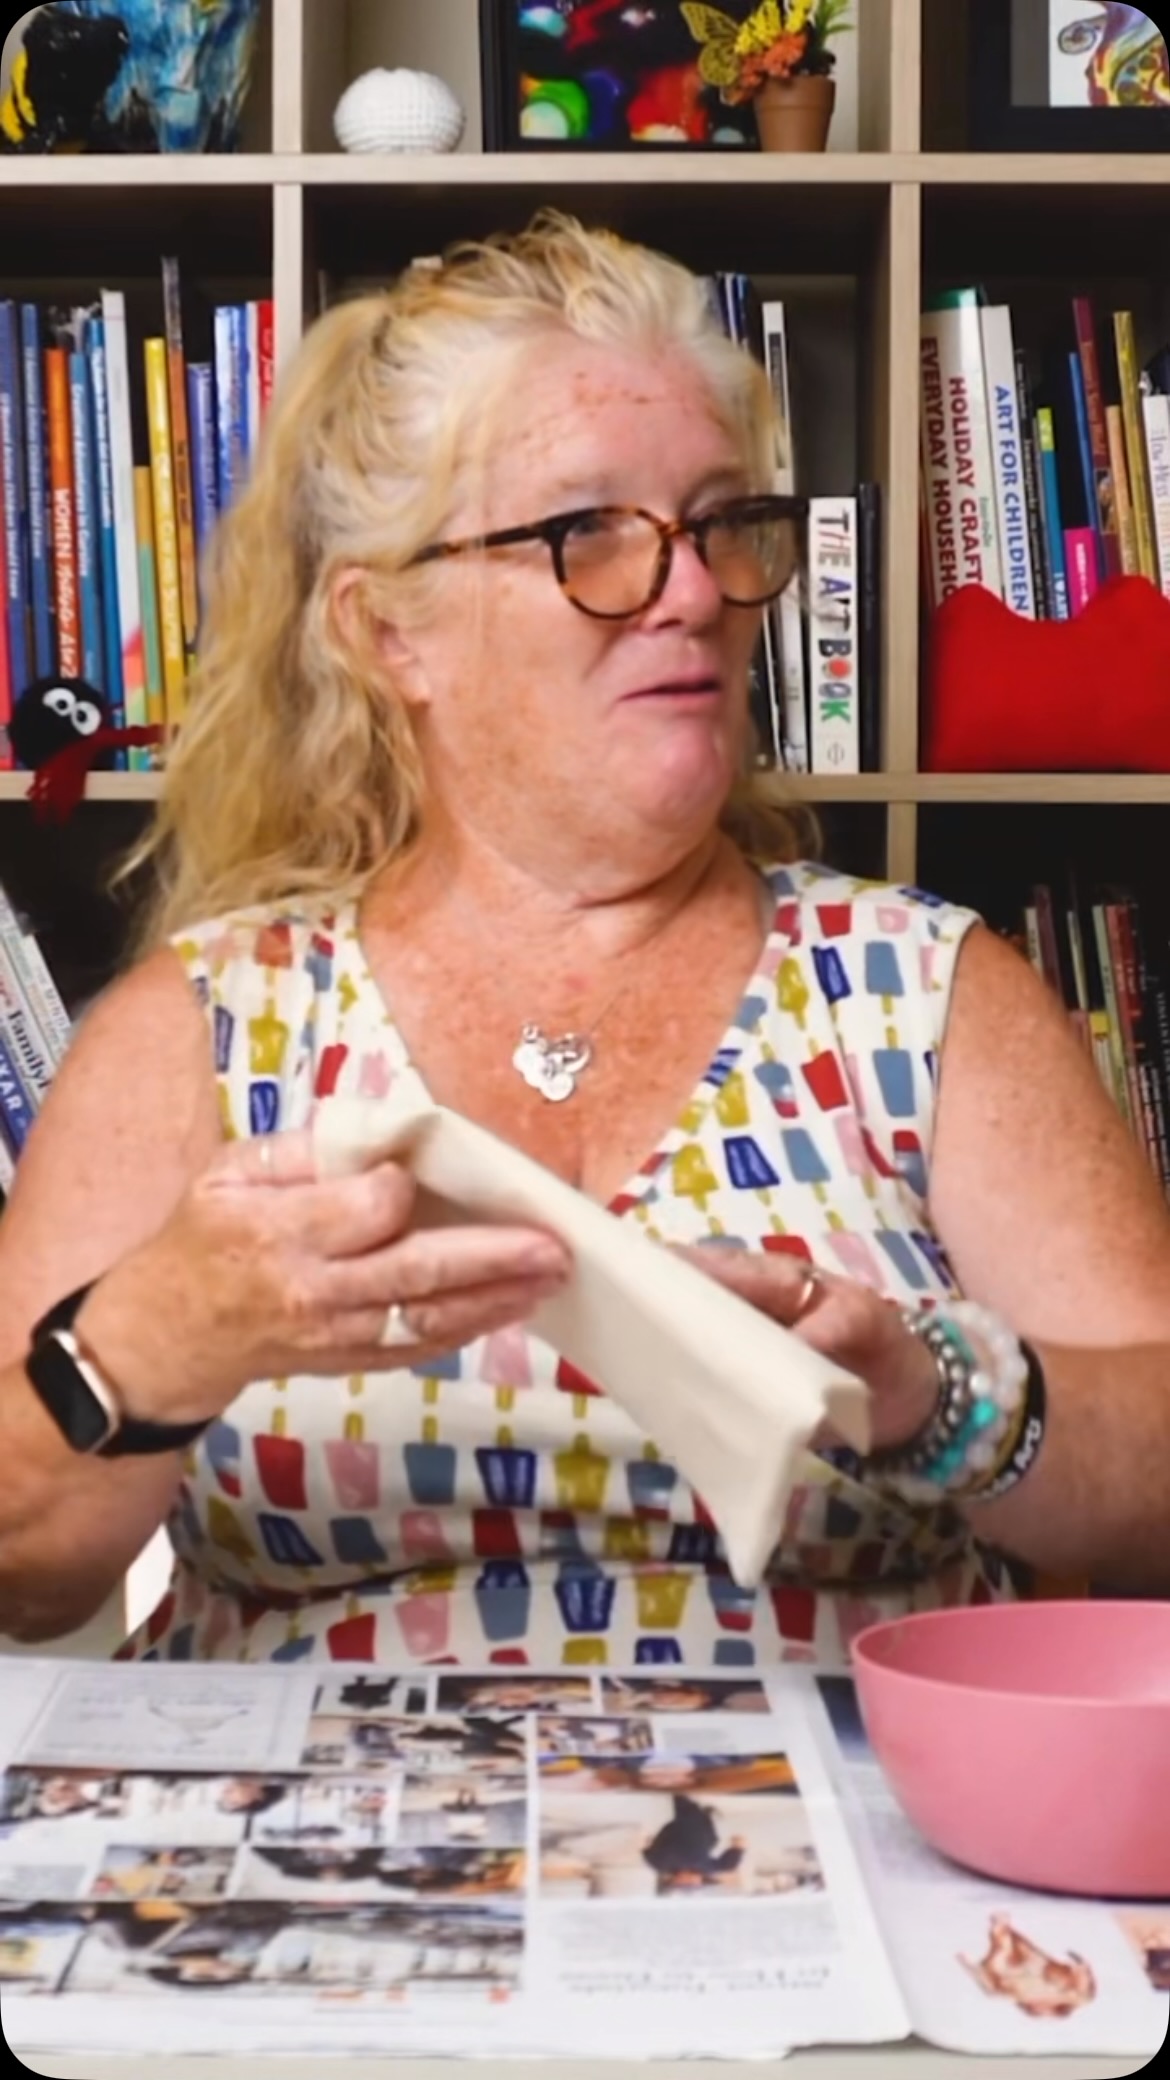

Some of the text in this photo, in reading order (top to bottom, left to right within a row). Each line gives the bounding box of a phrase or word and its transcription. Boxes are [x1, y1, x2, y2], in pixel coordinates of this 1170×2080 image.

[26, 406, 38, 441] Artists
[1, 445, 13, 479] Artists
[28, 443, 40, 487] Children
[72, 440, 90, 512] Adventures
[921, 337, 958, 598] EVERYDAY HOUSEHO
[949, 377, 983, 583] HOLIDAY CRAFT
[3, 482, 16, 527] Children
[30, 490, 42, 526] Should
[77, 514, 89, 527] in
[995, 386, 1029, 611] ART FOR CHILDREN
[32, 528, 43, 558] Know
[53, 487, 74, 559] WOMEN
[818, 509, 851, 566] THE
[6, 530, 18, 566] Should
[77, 529, 92, 576] Cursive
[8, 568, 20, 598] Know
[1055, 594, 1069, 620] ART
[60, 631, 73, 644] A
[818, 638, 852, 724] BOOK
